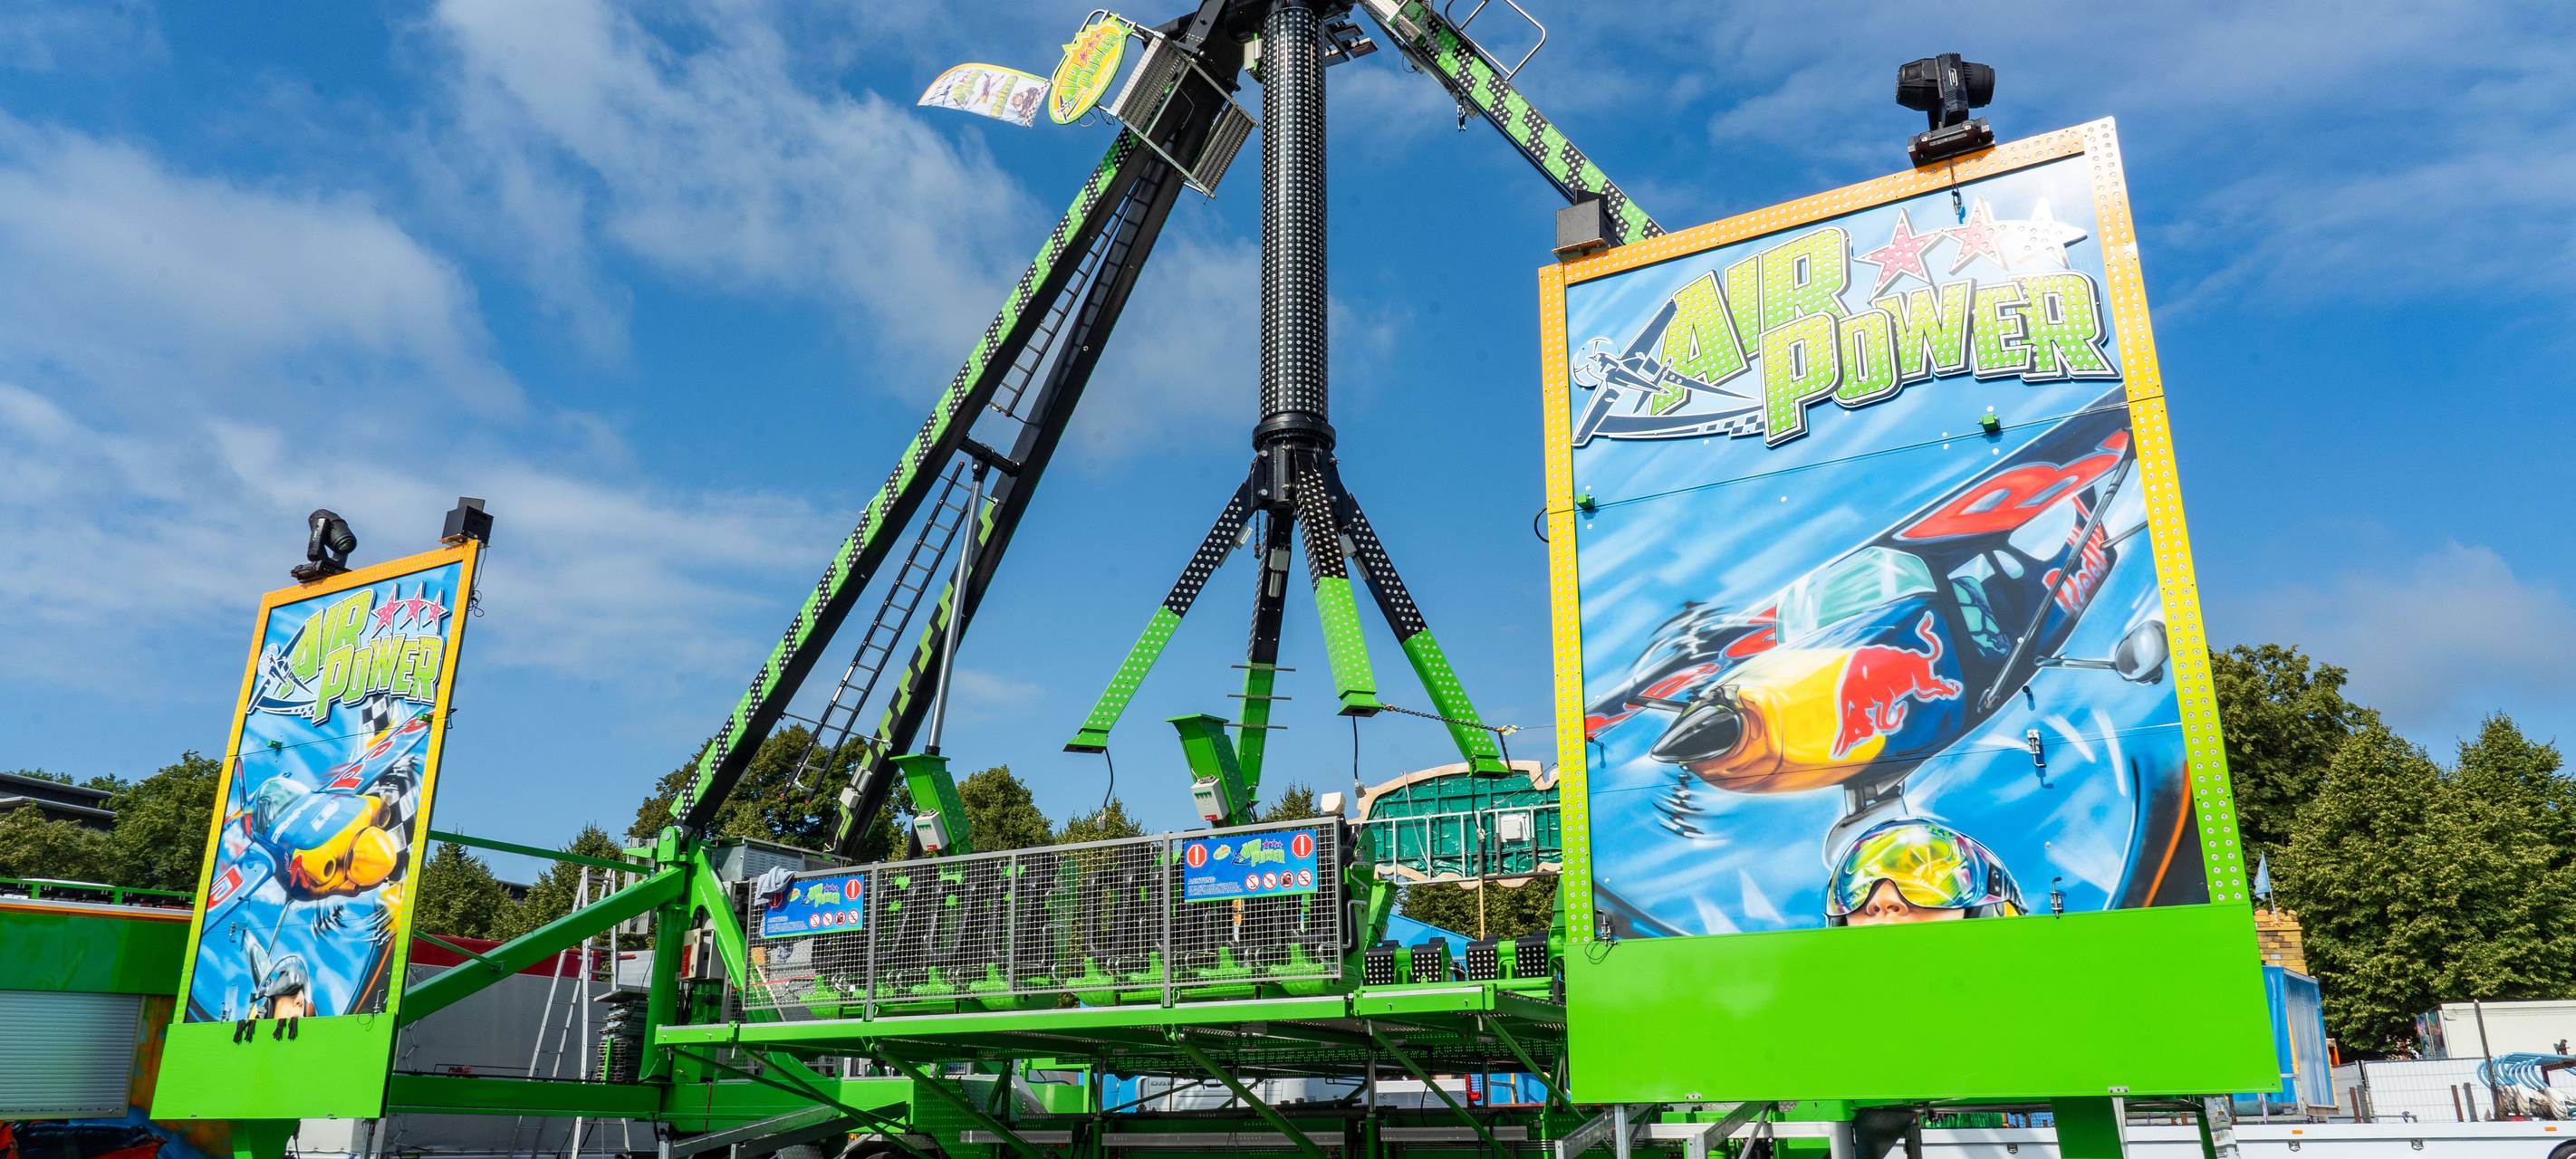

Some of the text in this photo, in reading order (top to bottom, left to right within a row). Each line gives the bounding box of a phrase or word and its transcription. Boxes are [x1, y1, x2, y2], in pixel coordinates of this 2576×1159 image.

[1649, 226, 1852, 417] AIR
[1758, 270, 2123, 448] POWER
[277, 588, 377, 700] AIR
[312, 633, 446, 727] POWER
